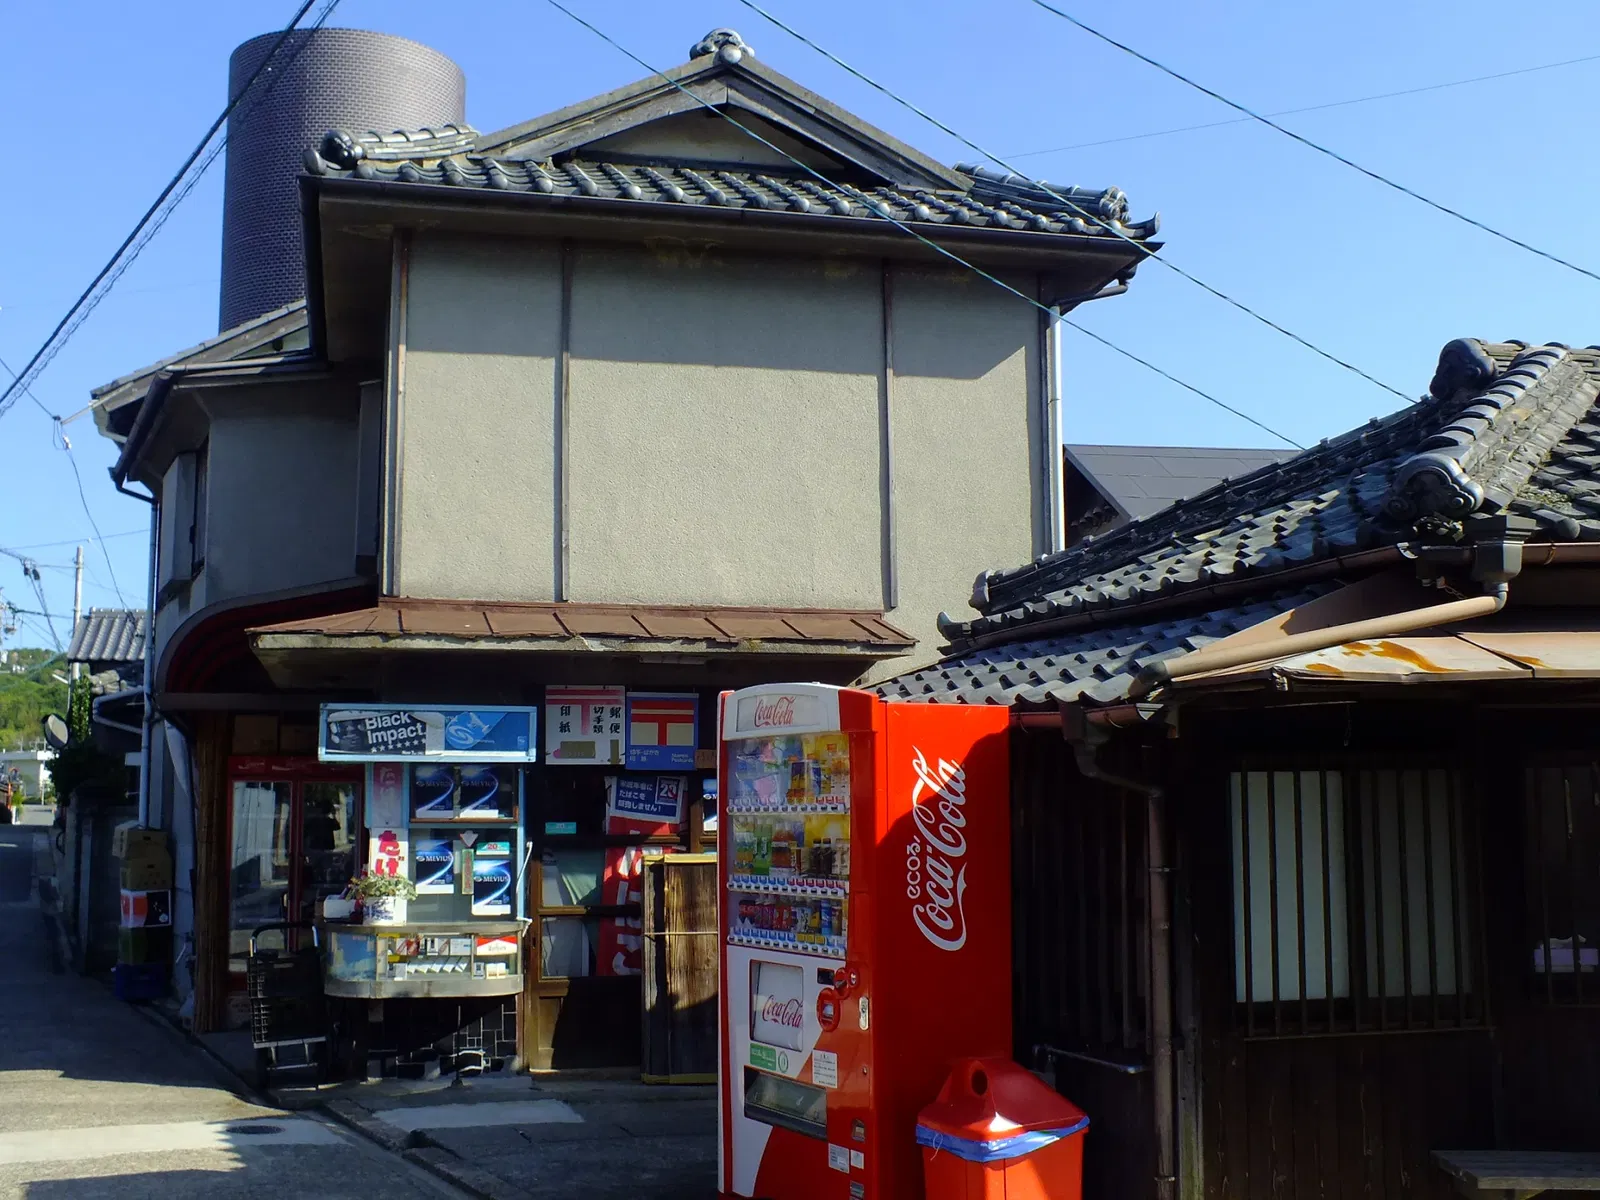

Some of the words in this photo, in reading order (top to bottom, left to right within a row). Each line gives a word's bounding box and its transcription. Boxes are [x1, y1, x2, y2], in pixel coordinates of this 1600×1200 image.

[364, 711, 411, 730] Black
[559, 705, 571, 734] 印紙
[593, 706, 604, 734] 切手類
[609, 706, 622, 734] 郵便
[425, 855, 452, 863] MEVIUS
[912, 744, 967, 951] Coca-Cola
